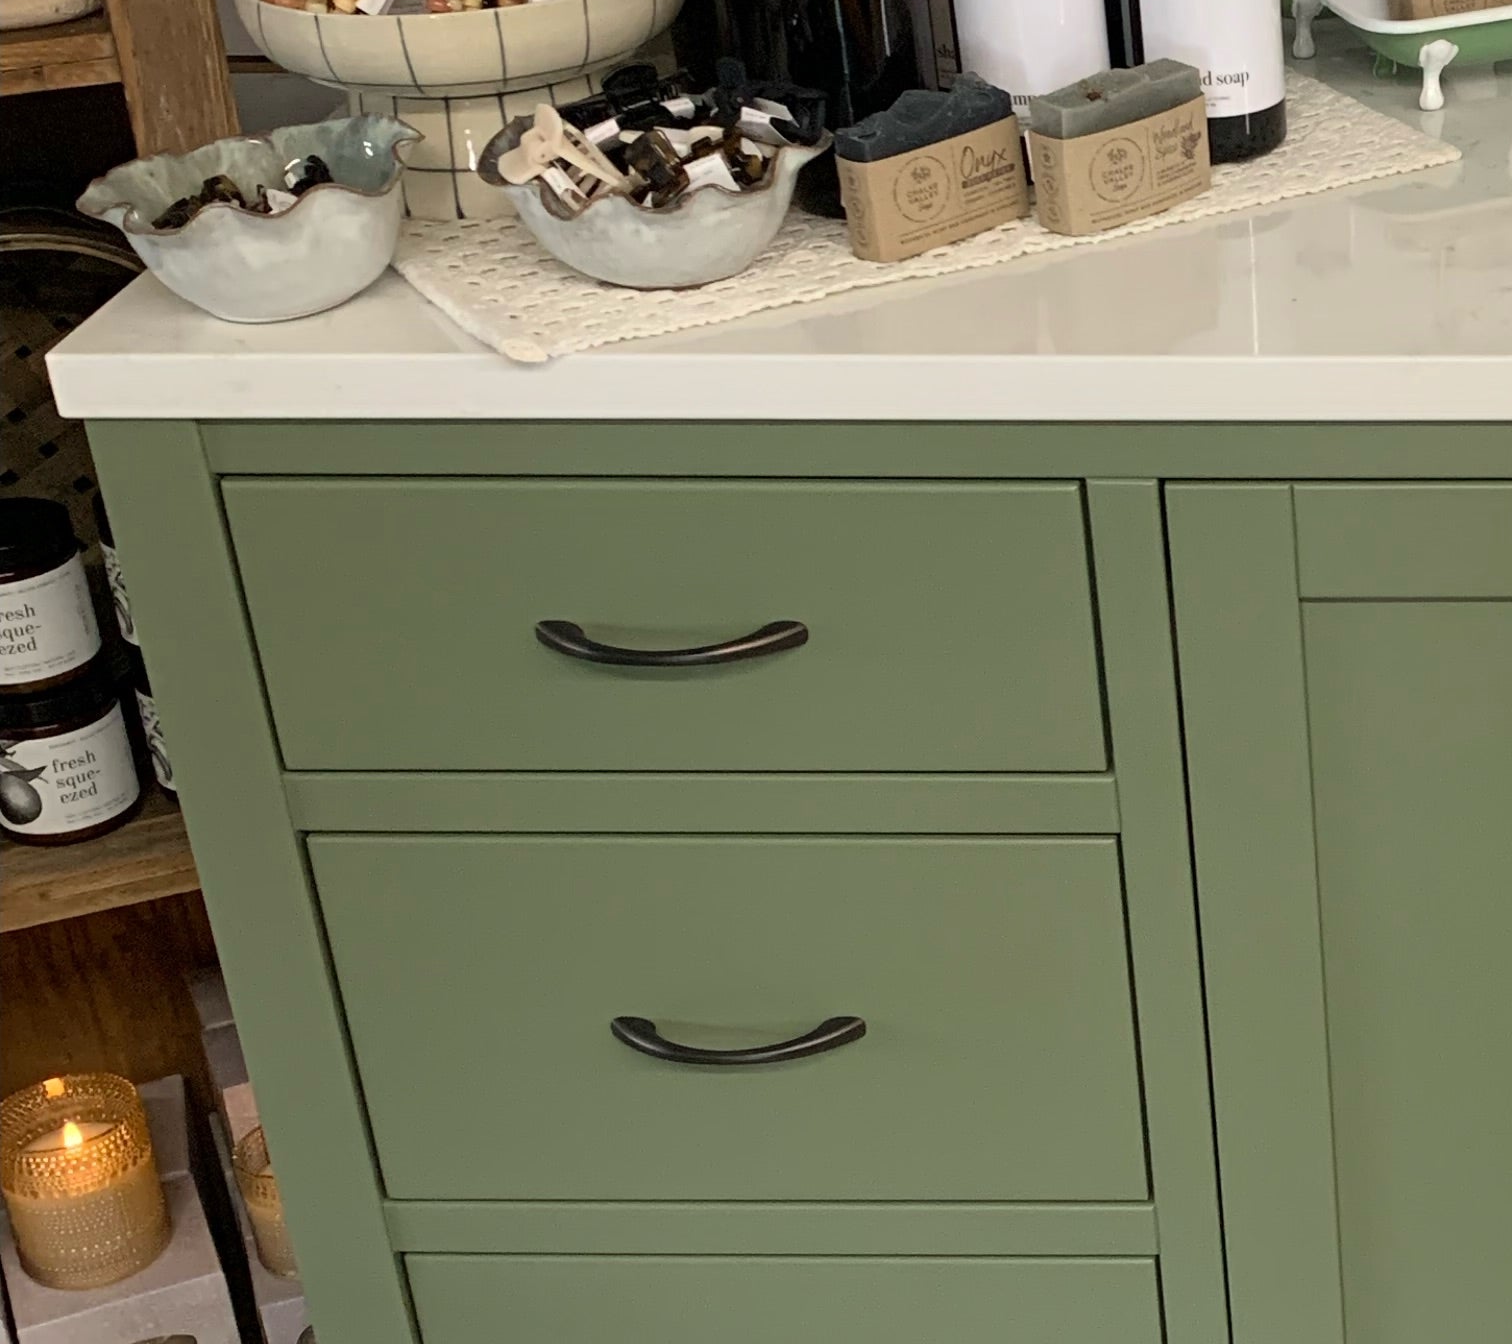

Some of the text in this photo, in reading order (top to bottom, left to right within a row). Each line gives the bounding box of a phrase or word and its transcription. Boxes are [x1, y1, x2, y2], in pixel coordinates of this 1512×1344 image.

[1216, 72, 1250, 87] soap
[960, 146, 1008, 179] Onyx
[0, 604, 36, 624] resh
[52, 750, 96, 773] fresh
[56, 769, 101, 789] sque-
[60, 782, 98, 804] ezed
